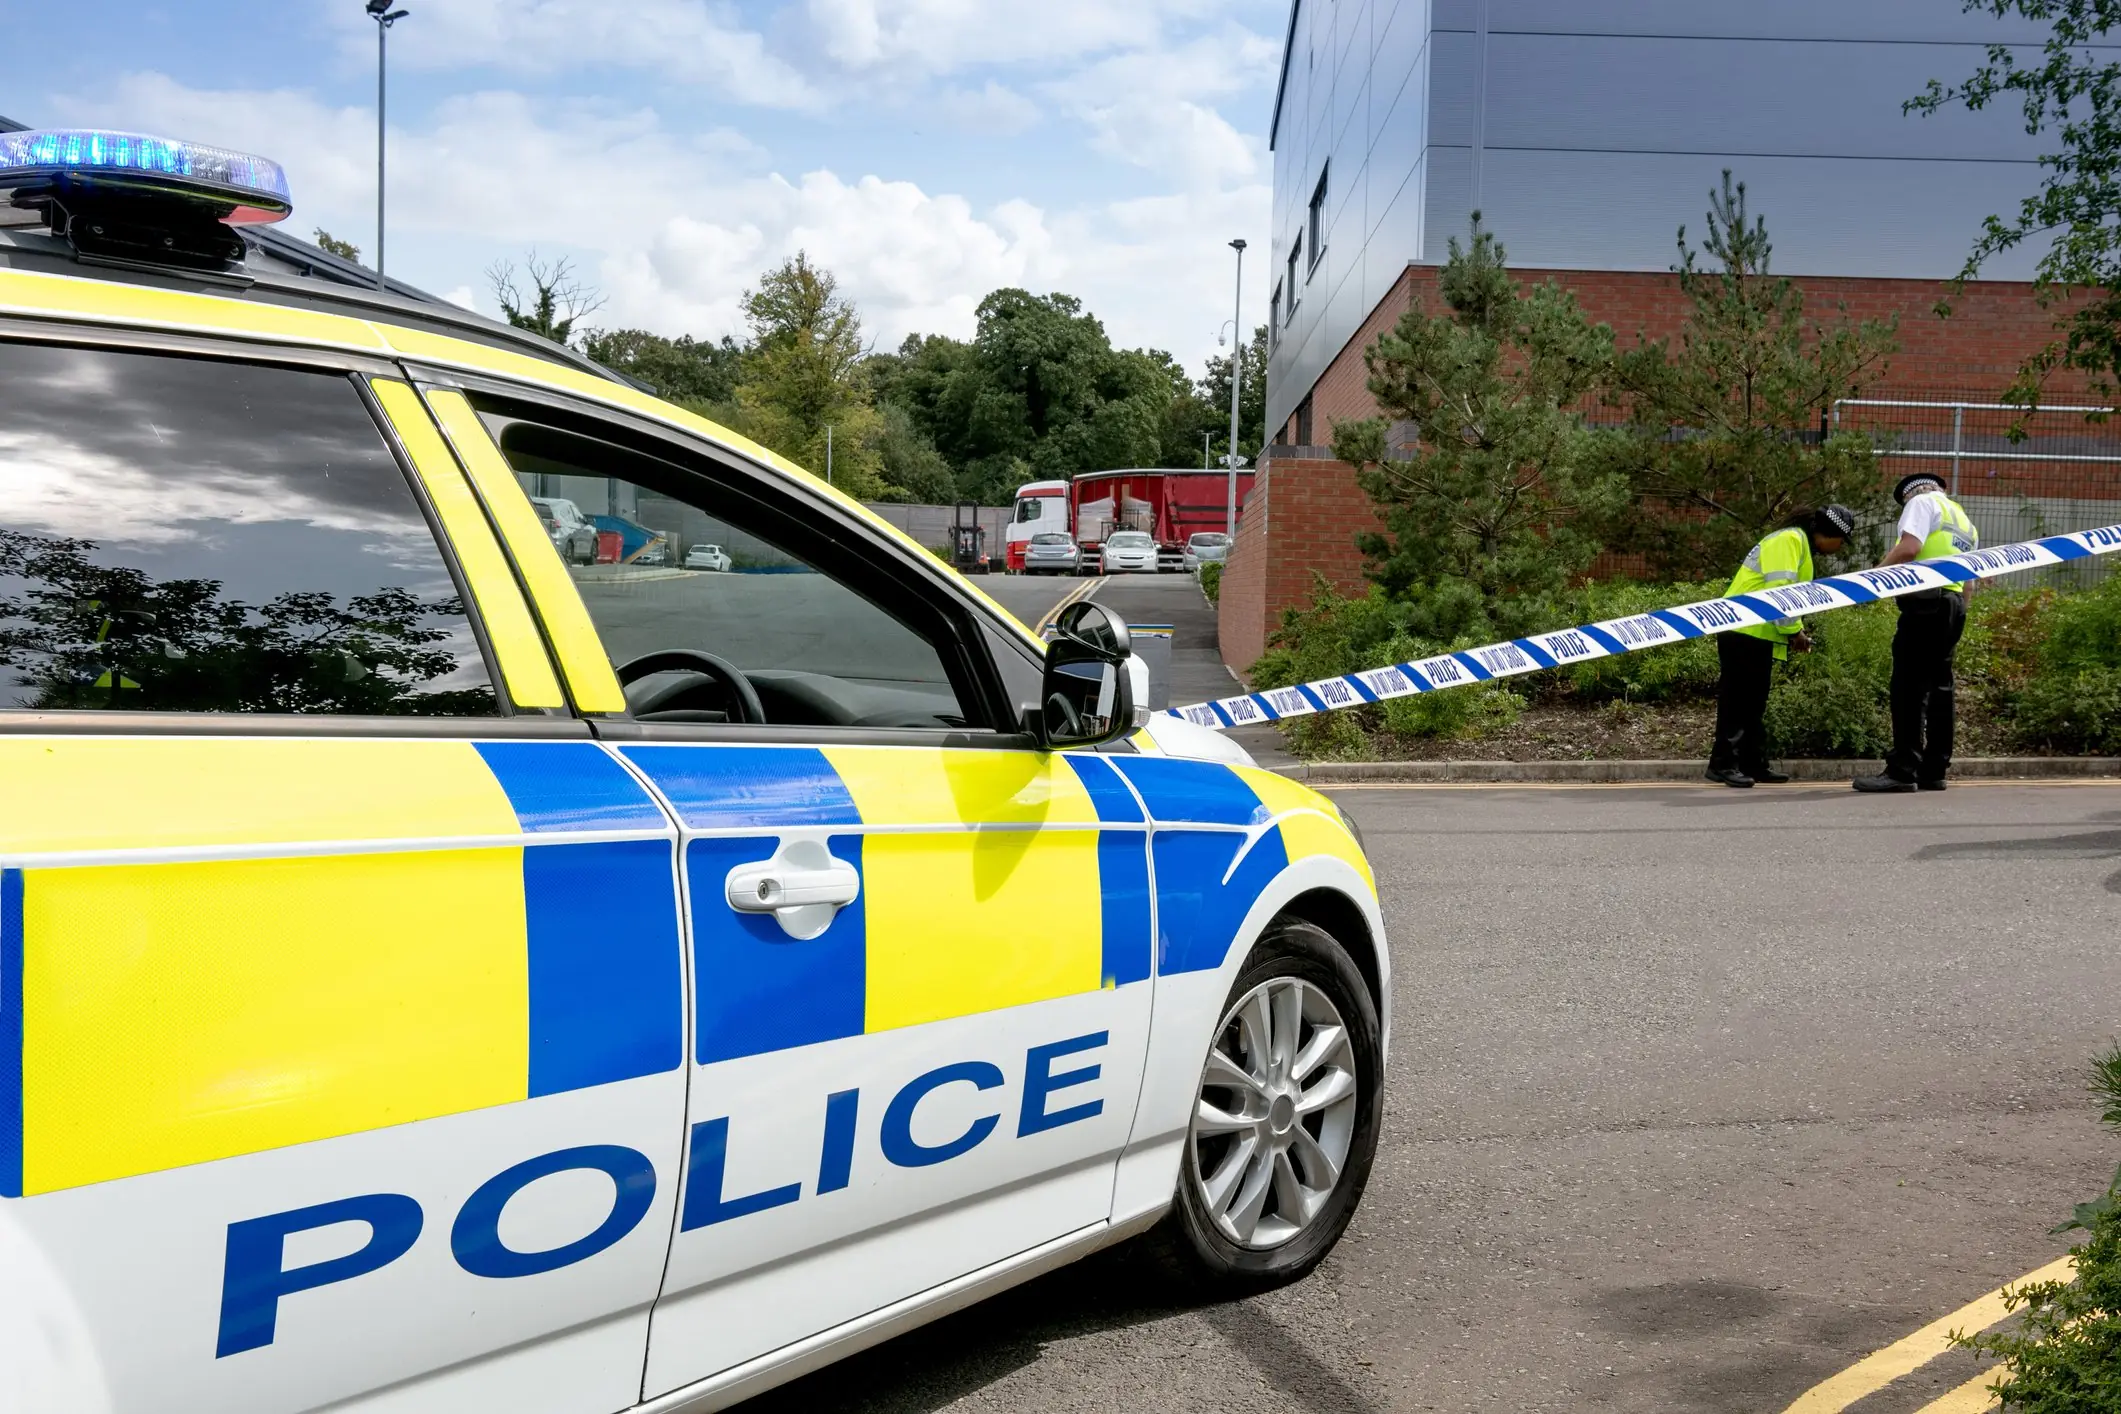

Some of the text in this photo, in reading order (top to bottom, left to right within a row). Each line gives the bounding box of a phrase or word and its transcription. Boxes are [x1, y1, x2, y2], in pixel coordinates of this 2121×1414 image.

[2079, 525, 2121, 548] POL
[1858, 566, 1925, 593] POLICE
[1764, 591, 1791, 613] DO
[1775, 587, 1808, 610] NOT
[1791, 582, 1834, 607] CROSS
[1687, 601, 1743, 629] POLICE
[1544, 632, 1591, 660] POLICE
[1424, 658, 1462, 685] POLICE
[1319, 680, 1352, 705] POLICE
[1228, 698, 1257, 721] POLICE
[215, 1030, 1109, 1359] POLICE
